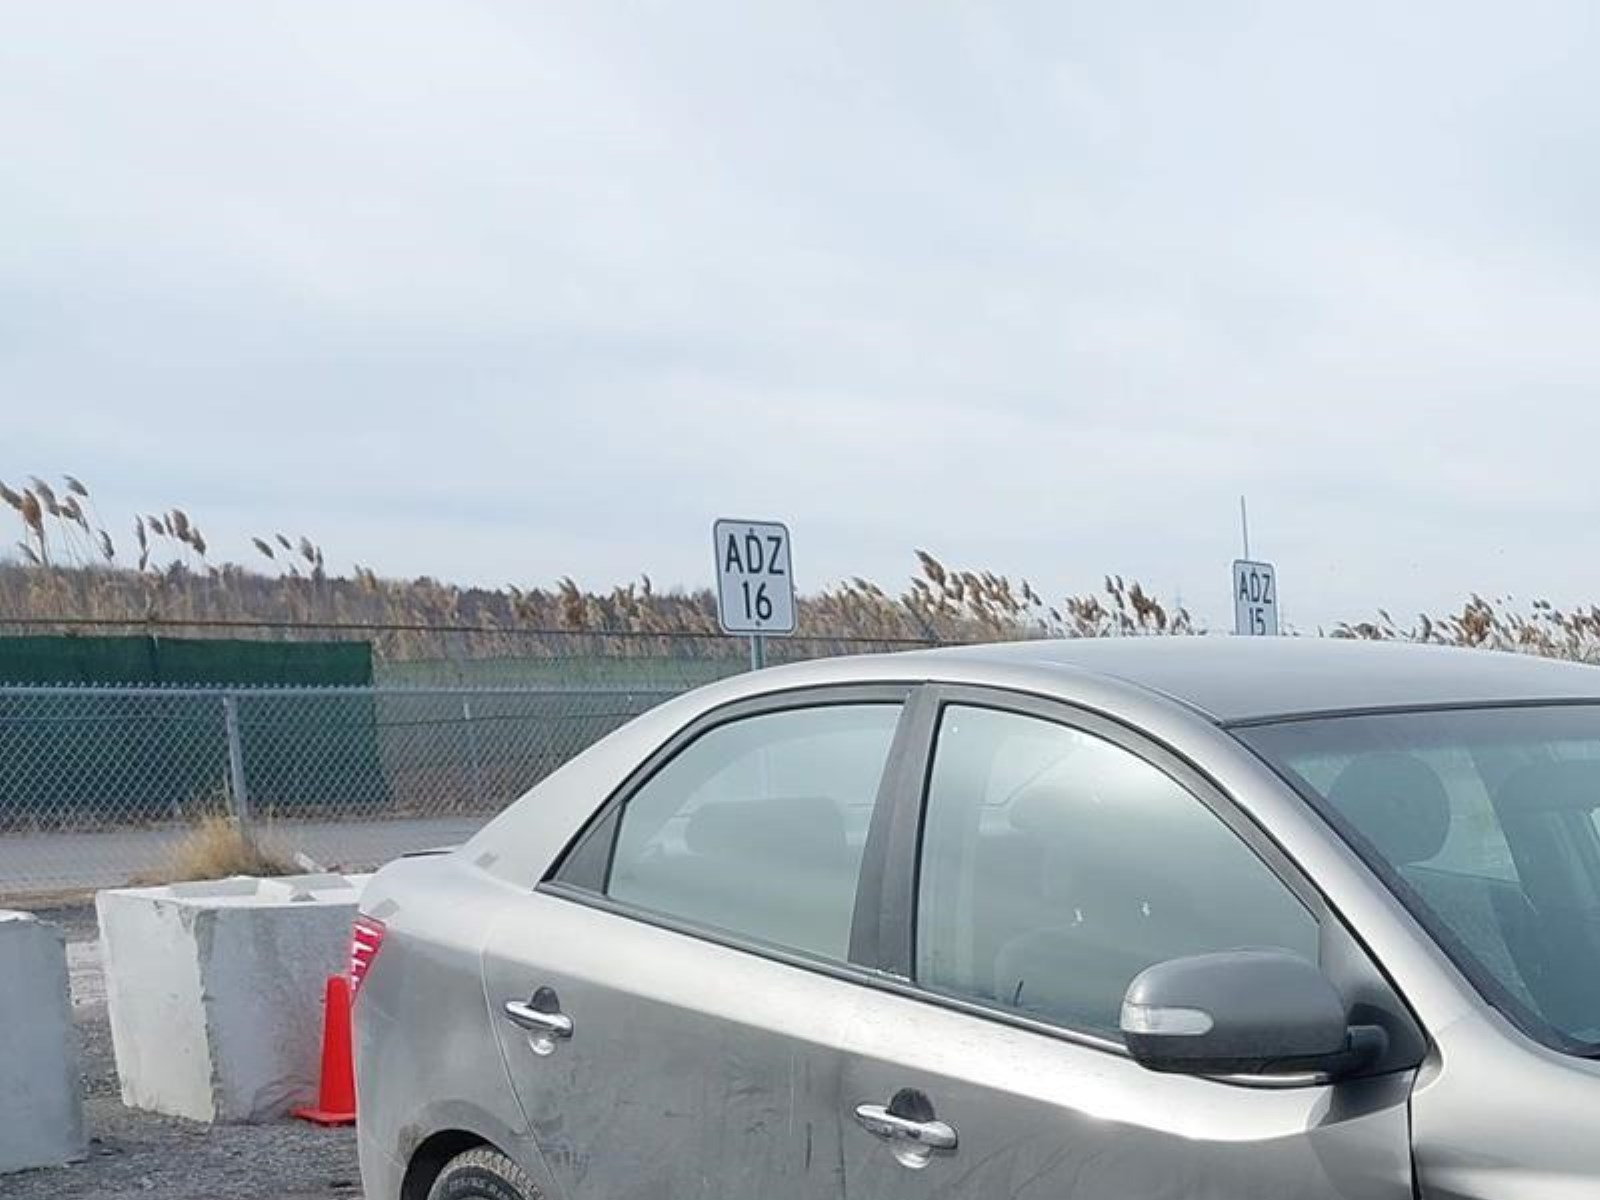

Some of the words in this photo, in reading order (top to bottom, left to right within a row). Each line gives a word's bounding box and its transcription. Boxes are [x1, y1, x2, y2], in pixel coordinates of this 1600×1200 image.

[725, 533, 785, 575] ADZ
[742, 581, 772, 620] 16
[1239, 571, 1272, 604] ADZ
[1249, 607, 1266, 635] 15
